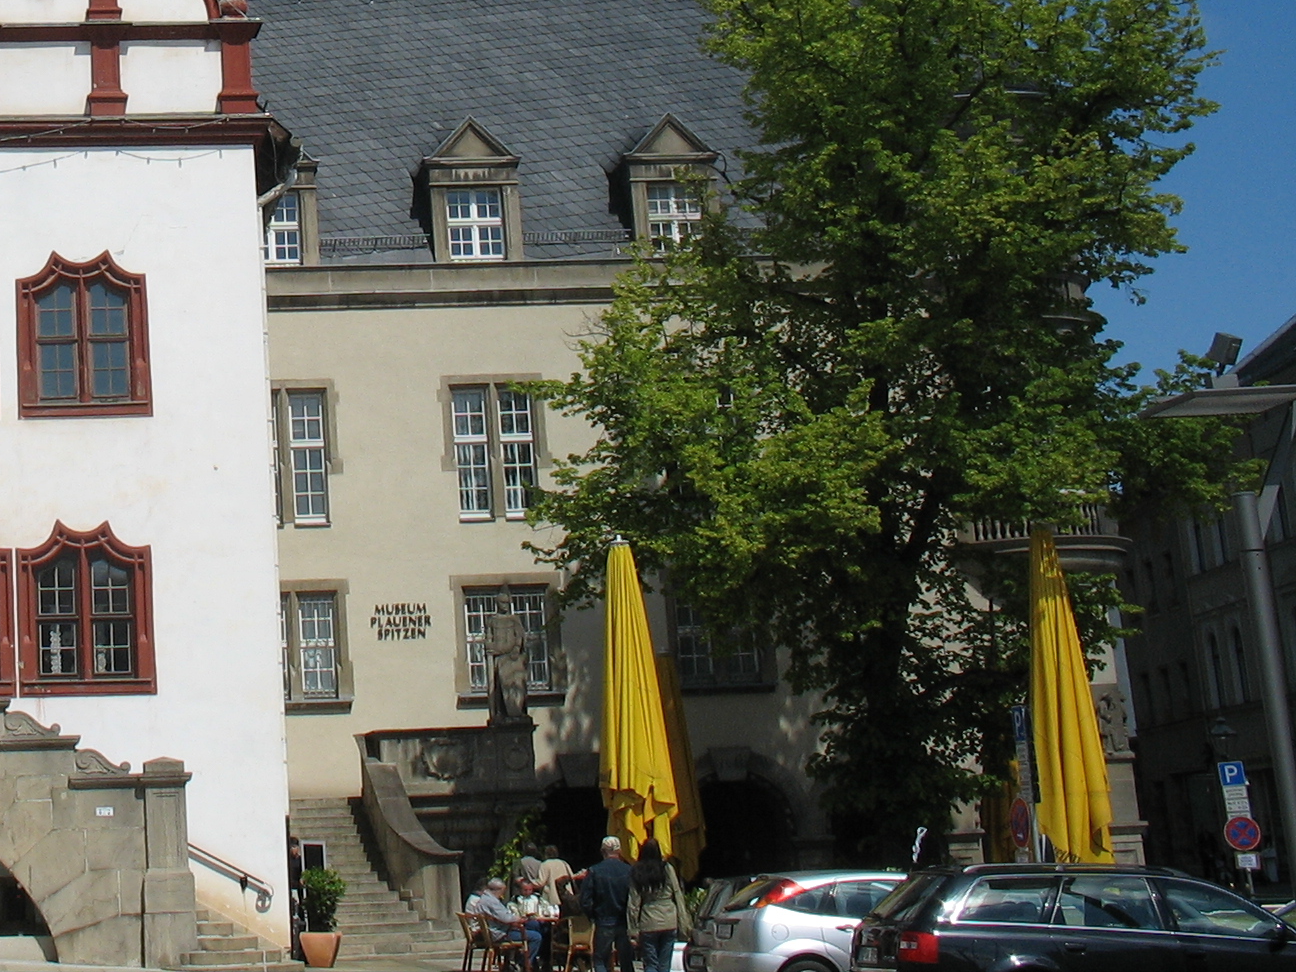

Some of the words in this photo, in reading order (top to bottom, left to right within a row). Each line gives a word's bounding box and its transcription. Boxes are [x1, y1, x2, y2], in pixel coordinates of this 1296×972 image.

[374, 603, 427, 616] MUSEUM
[370, 615, 432, 628] PLAUENER
[377, 628, 426, 641] SPITZEN
[1224, 764, 1238, 783] P
